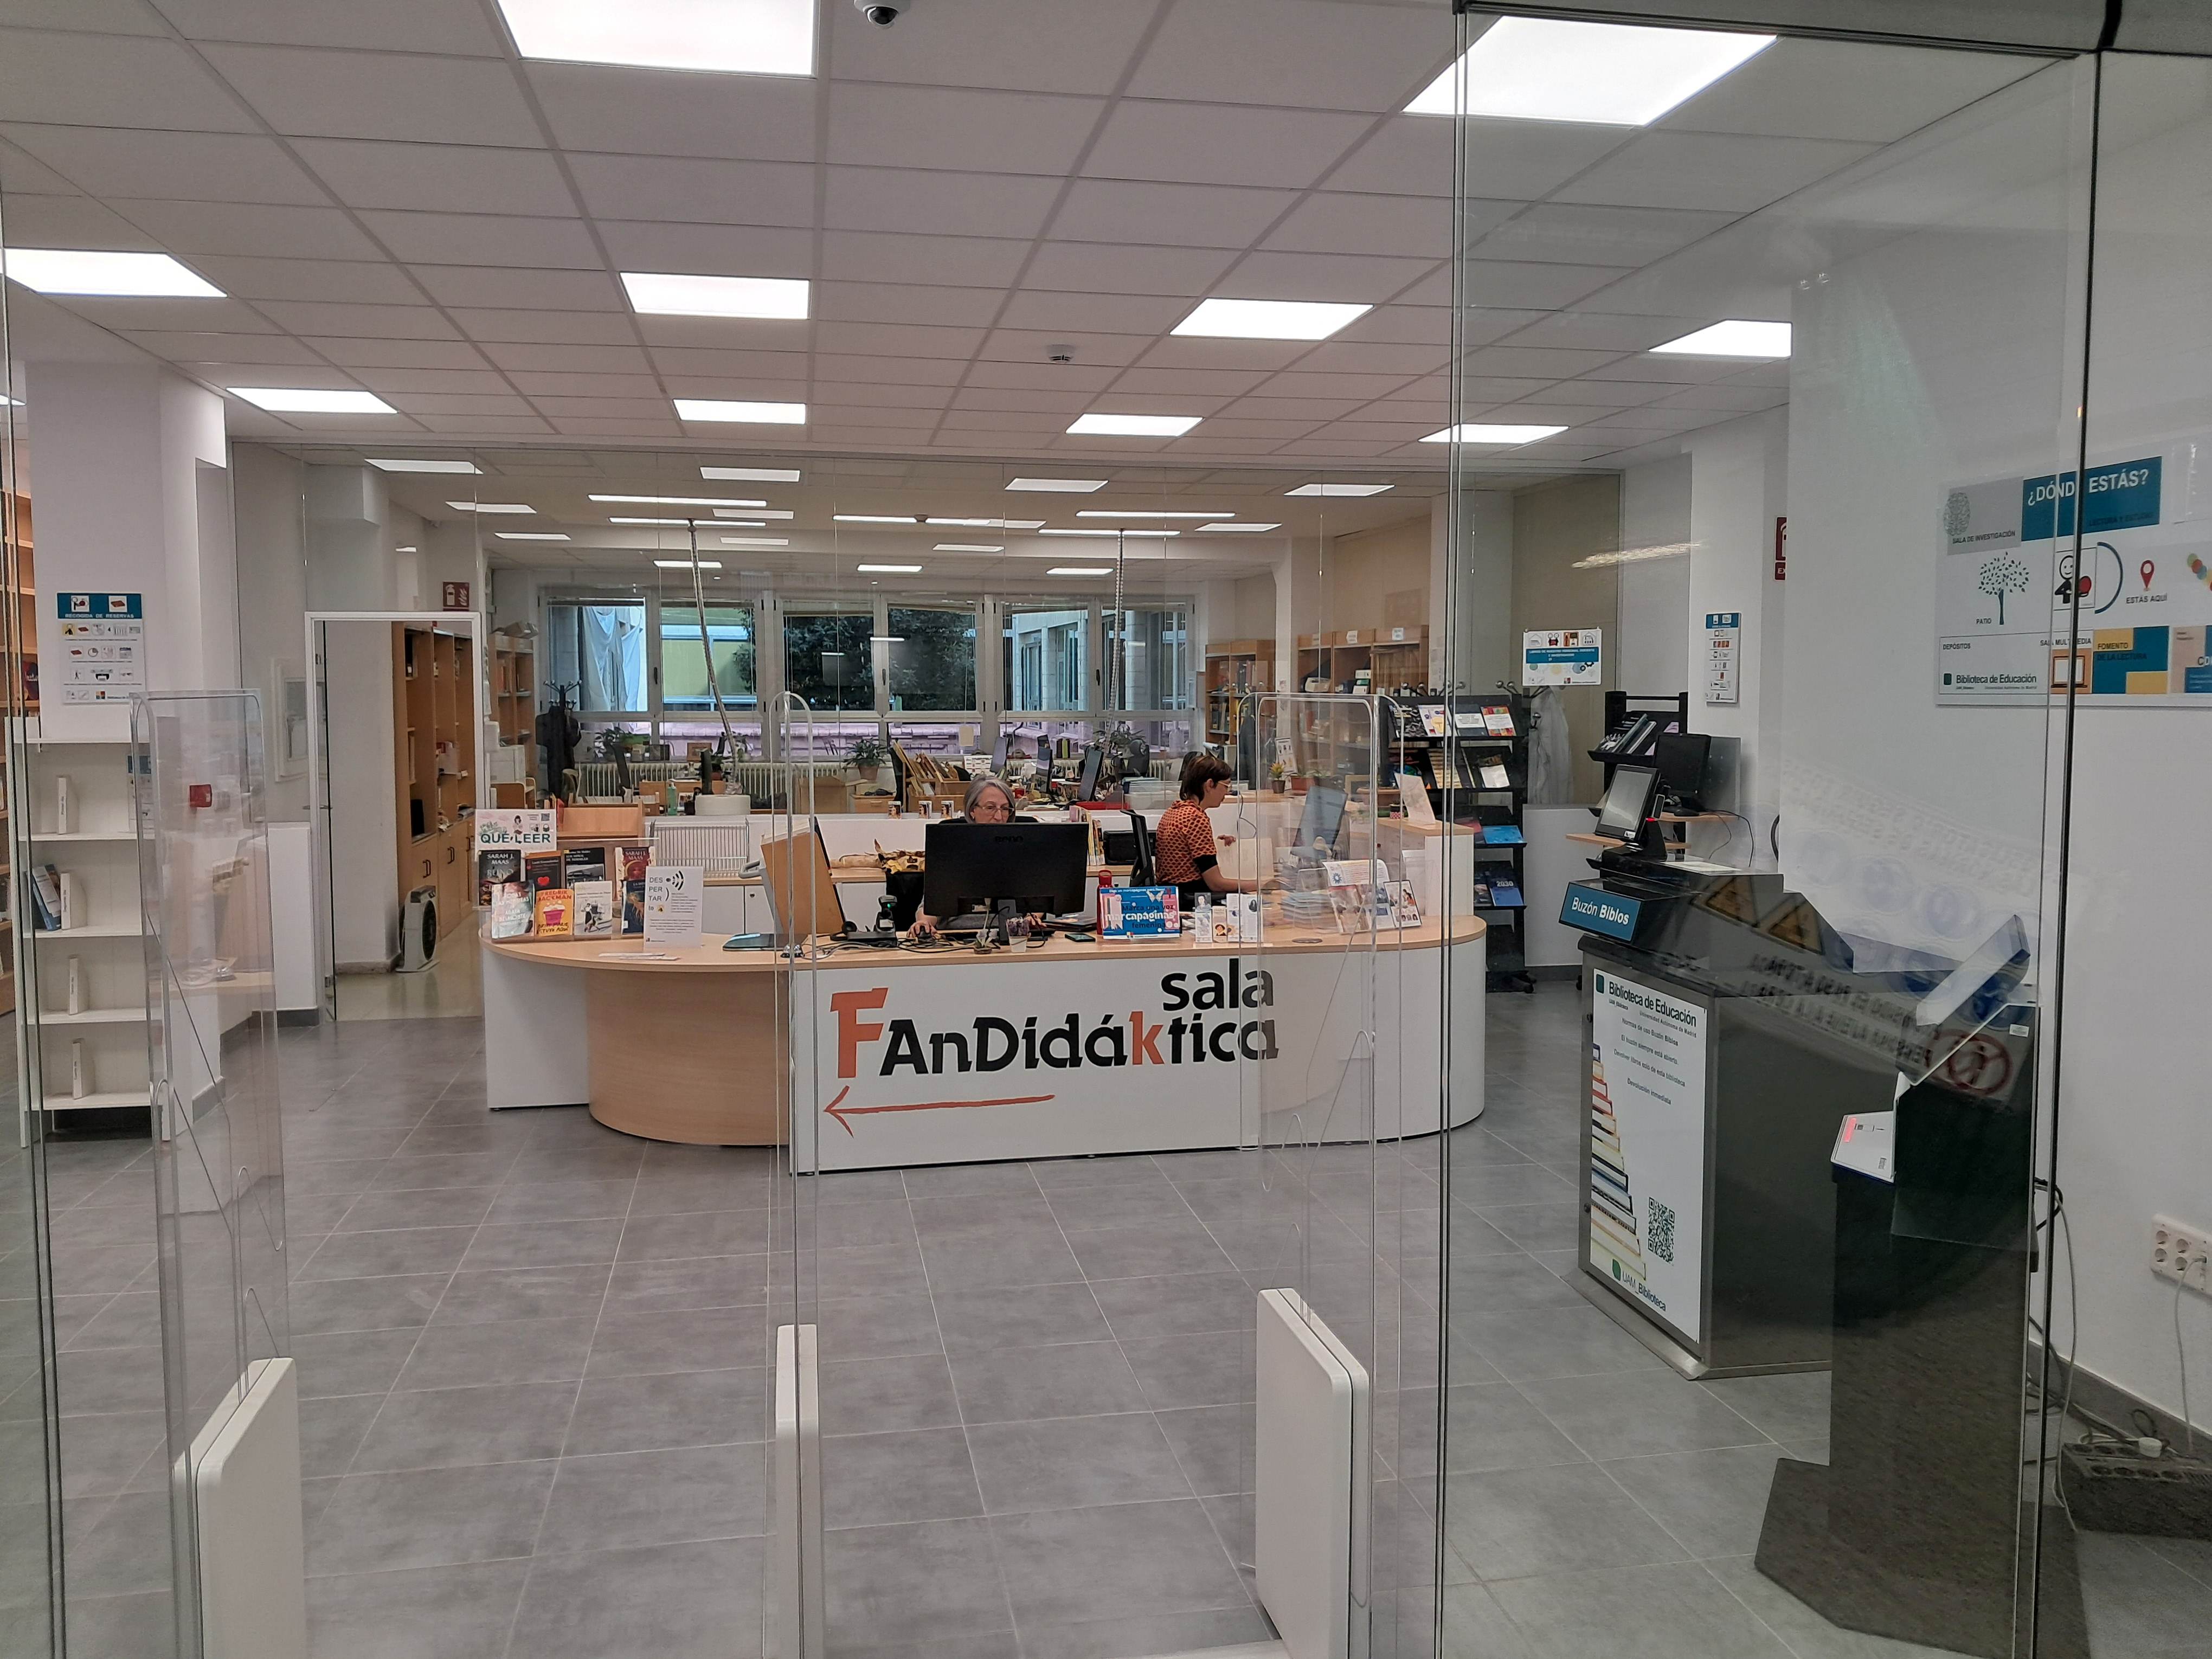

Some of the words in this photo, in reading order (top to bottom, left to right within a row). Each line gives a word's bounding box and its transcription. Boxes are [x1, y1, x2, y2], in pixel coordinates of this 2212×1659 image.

[2028, 479, 2076, 506] ¿DÓND
[2088, 468, 2149, 494] ESTÁS?
[1953, 535, 1966, 544] SALA
[1975, 529, 2016, 542] INVESTIGACIÓN
[2126, 595, 2148, 604] ESTÁS
[2150, 593, 2168, 602] AQUÍ
[1943, 642, 1971, 650] DEPÓSITOS
[2055, 637, 2091, 646] MULTEDIA
[2098, 642, 2129, 650] FOMENTO
[1956, 674, 1988, 684] Biblioteca
[1989, 674, 1998, 683] de
[1999, 673, 2037, 683] Educación
[515, 833, 551, 844] LEER
[1571, 896, 1598, 917] Buzón
[1599, 904, 1630, 925] Biblos
[1160, 957, 1275, 1012] sala
[1609, 981, 1643, 1006] Biblioteca
[1644, 995, 1654, 1010] de
[1655, 998, 1696, 1027] Educación
[1684, 1027, 1696, 1038] Madrid
[1664, 1034, 1679, 1046] Biblos
[1627, 1077, 1650, 1094] Devolución
